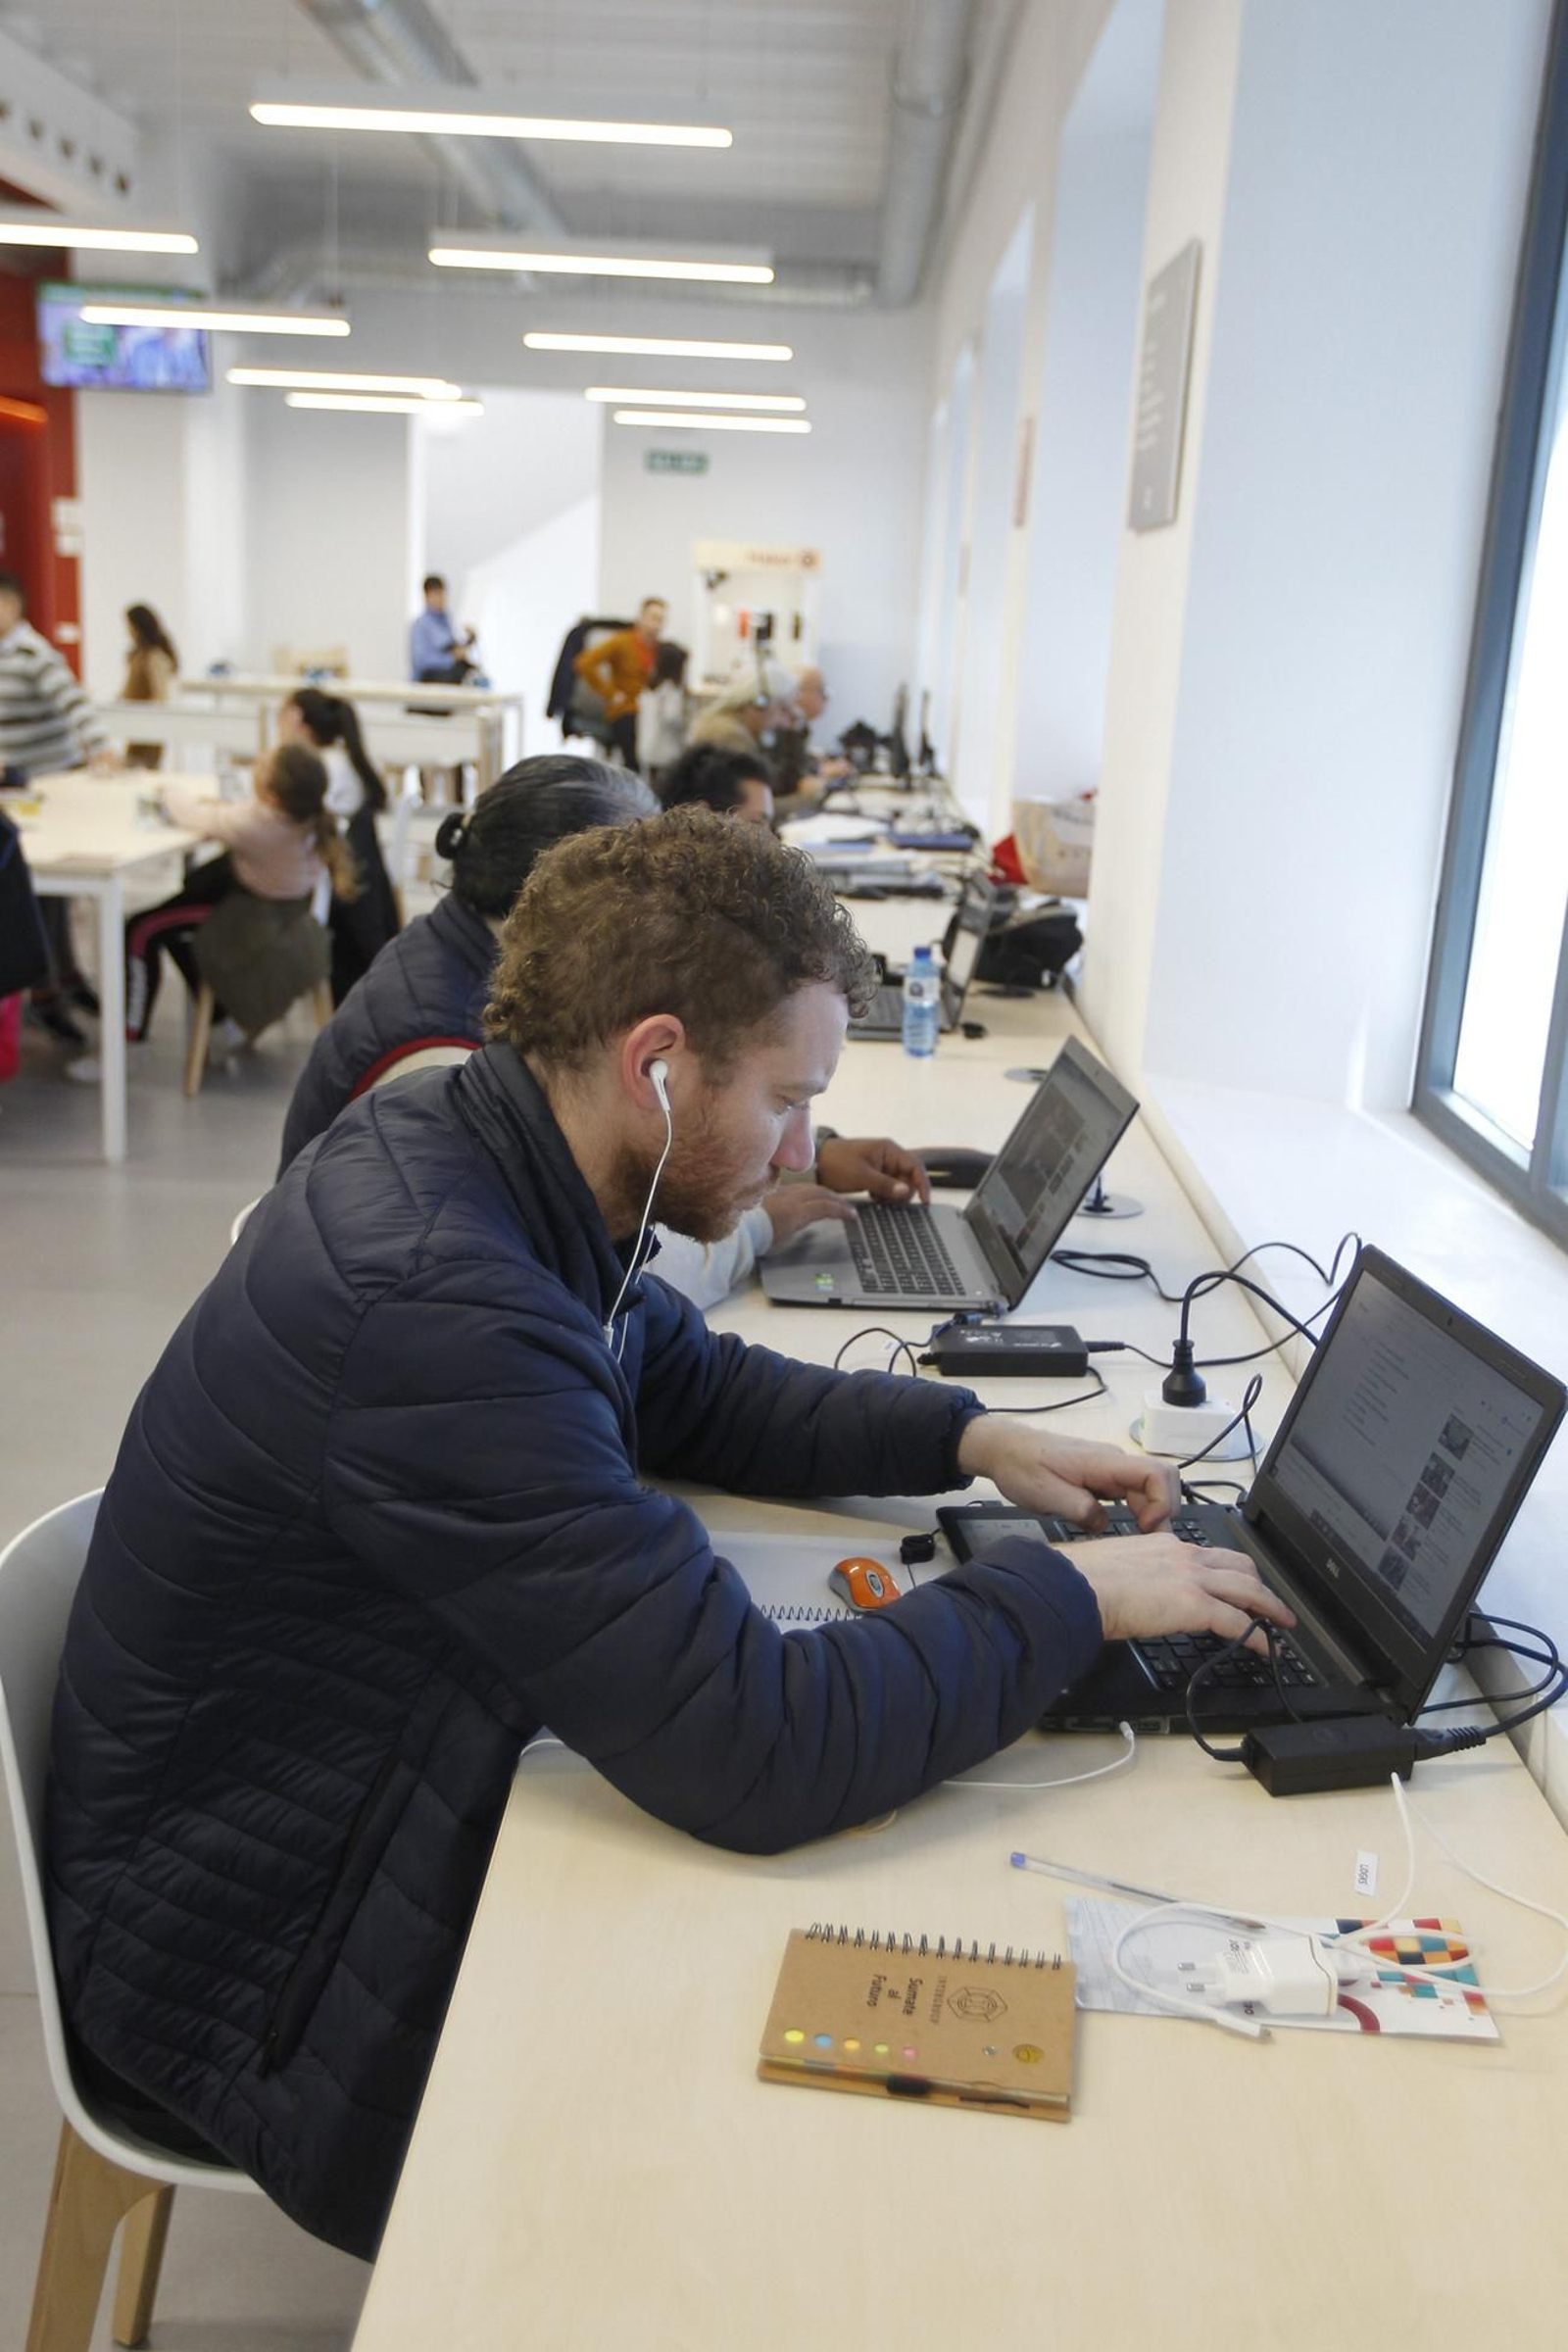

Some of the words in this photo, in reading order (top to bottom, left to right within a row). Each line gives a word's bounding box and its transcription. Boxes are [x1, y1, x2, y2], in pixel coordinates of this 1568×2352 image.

[866, 1974, 887, 2008] Futuro
[887, 1988, 902, 1999] al
[902, 1977, 923, 2016] Sumate
